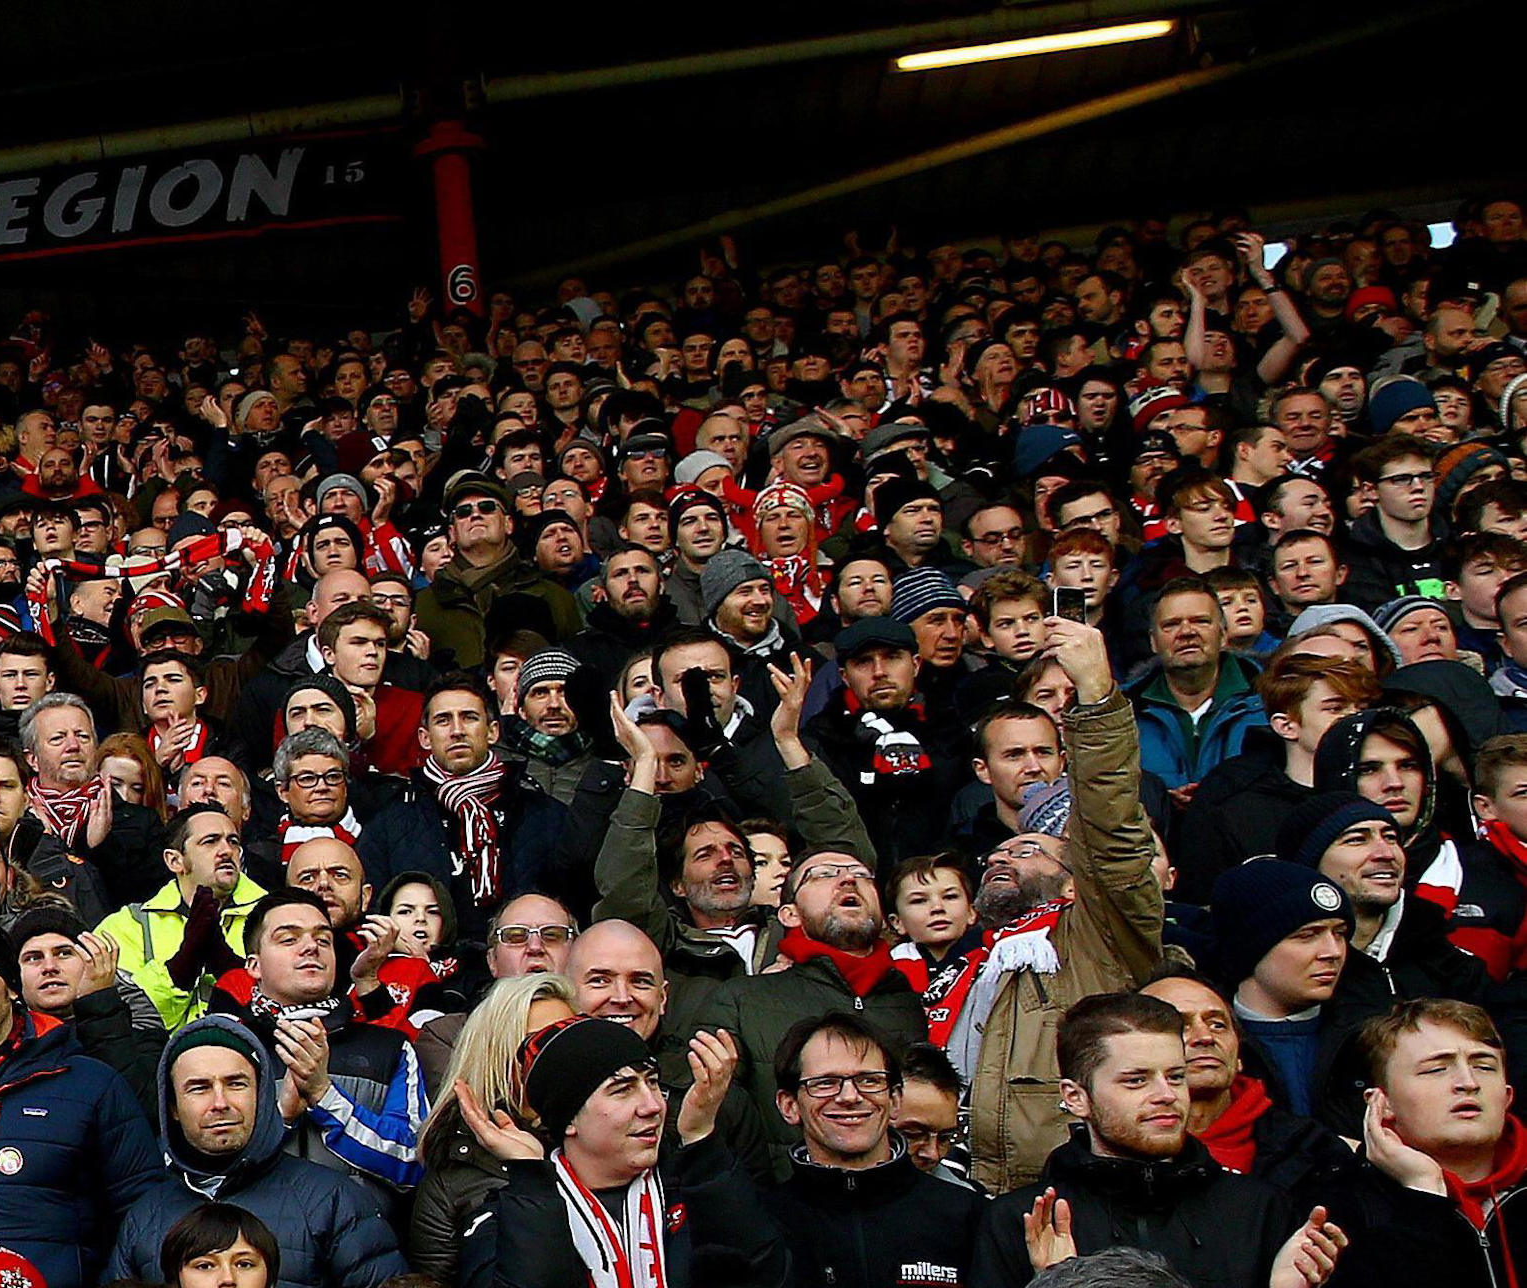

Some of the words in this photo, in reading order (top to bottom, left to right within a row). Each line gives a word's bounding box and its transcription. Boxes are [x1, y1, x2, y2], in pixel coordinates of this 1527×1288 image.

[323, 160, 366, 185] 15
[447, 264, 477, 306] 6
[901, 1261, 958, 1279] millers
